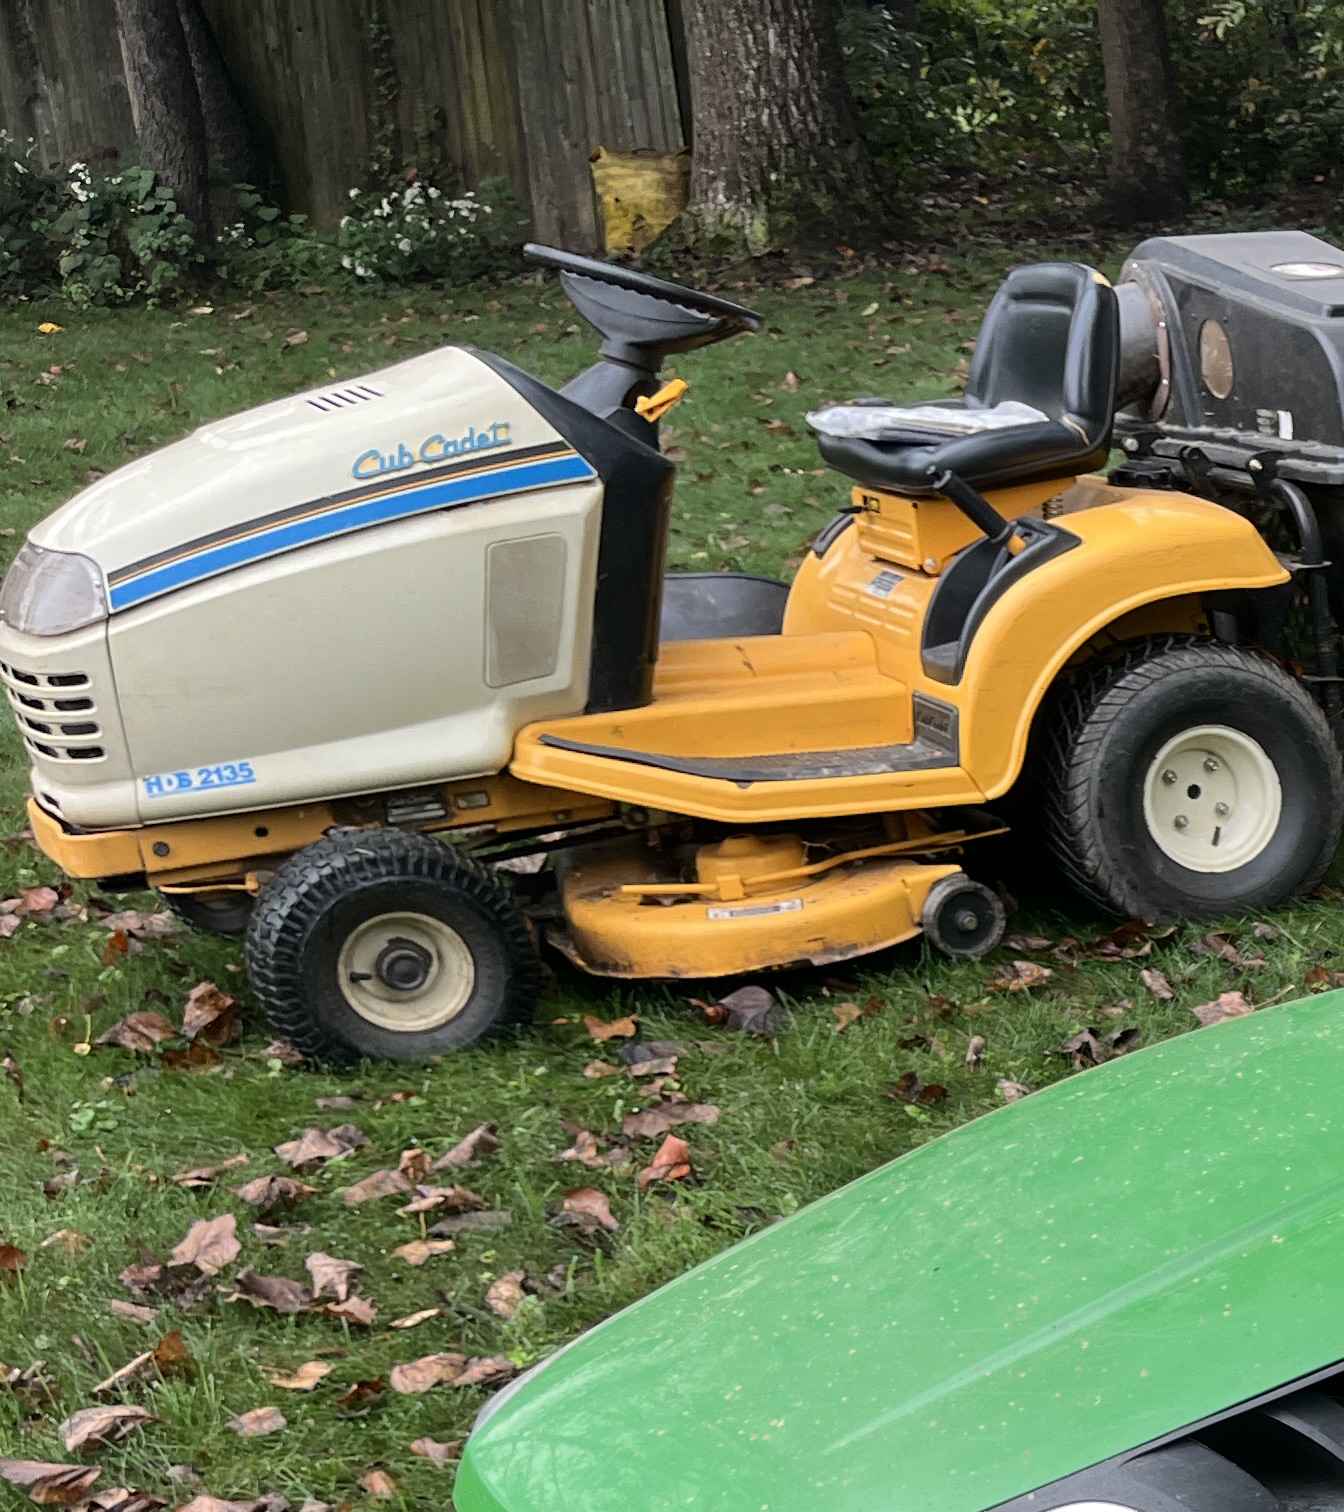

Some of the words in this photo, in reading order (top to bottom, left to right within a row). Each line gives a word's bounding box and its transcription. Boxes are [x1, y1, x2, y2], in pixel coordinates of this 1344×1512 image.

[352, 442, 414, 479] Cub
[419, 422, 512, 463] Cadet
[198, 762, 255, 785] 2135
